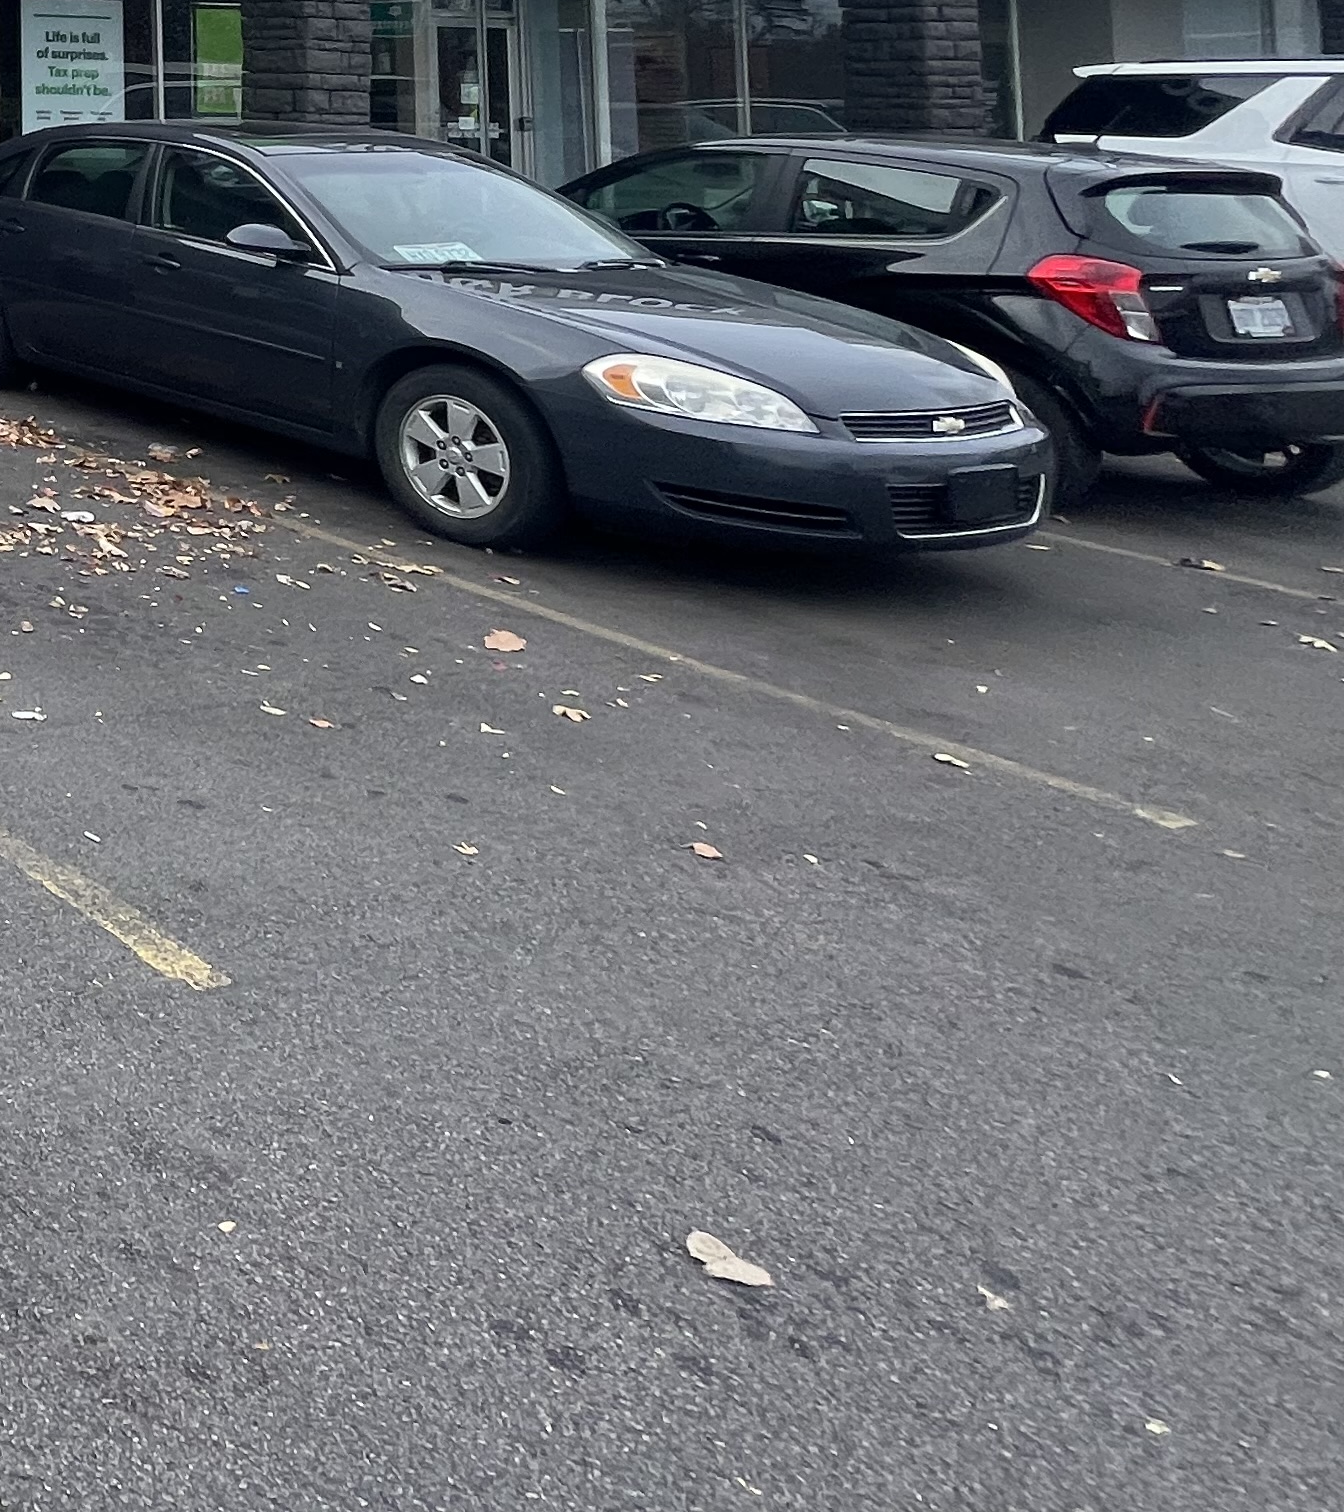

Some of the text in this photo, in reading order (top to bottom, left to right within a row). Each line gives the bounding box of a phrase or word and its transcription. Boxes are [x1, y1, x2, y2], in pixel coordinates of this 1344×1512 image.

[45, 31, 100, 44] Life is full
[36, 47, 109, 62] of surprises.
[47, 66, 99, 80] Tax prep
